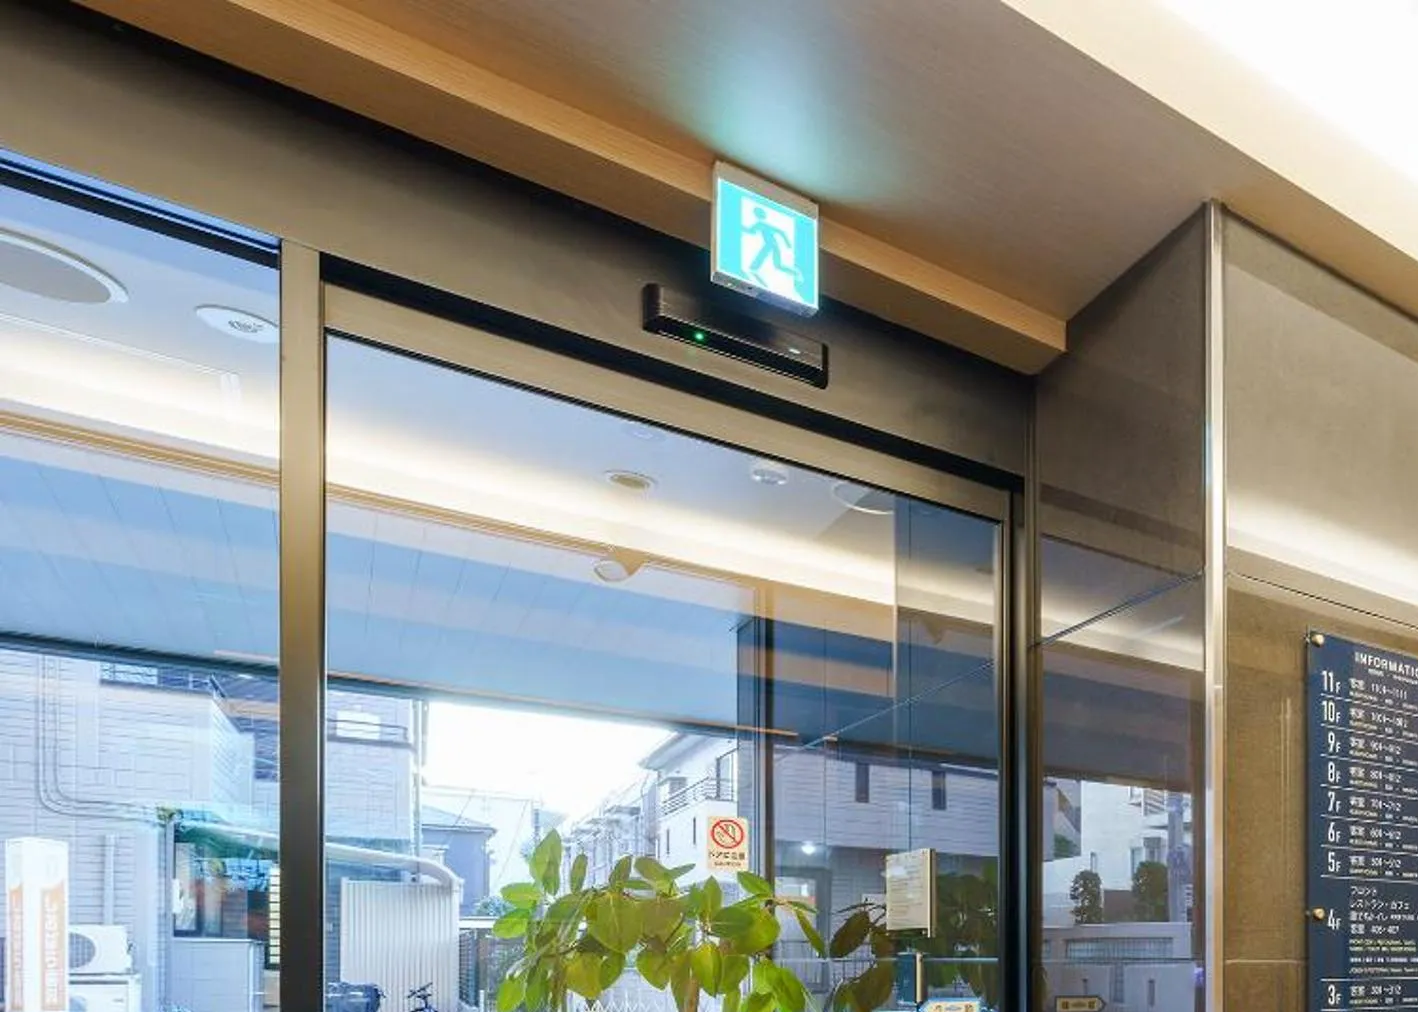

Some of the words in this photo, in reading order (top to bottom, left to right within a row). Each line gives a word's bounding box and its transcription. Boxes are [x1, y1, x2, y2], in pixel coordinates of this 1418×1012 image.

[1320, 670, 1341, 693] 11F
[1320, 700, 1341, 723] 10F
[1327, 731, 1341, 753] 9F
[1327, 761, 1341, 783] 8F
[1327, 791, 1341, 813] 7F
[1327, 821, 1341, 843] 6F
[1327, 851, 1341, 873] 5F
[1327, 908, 1341, 930] 4F
[1327, 984, 1341, 1005] 3F
